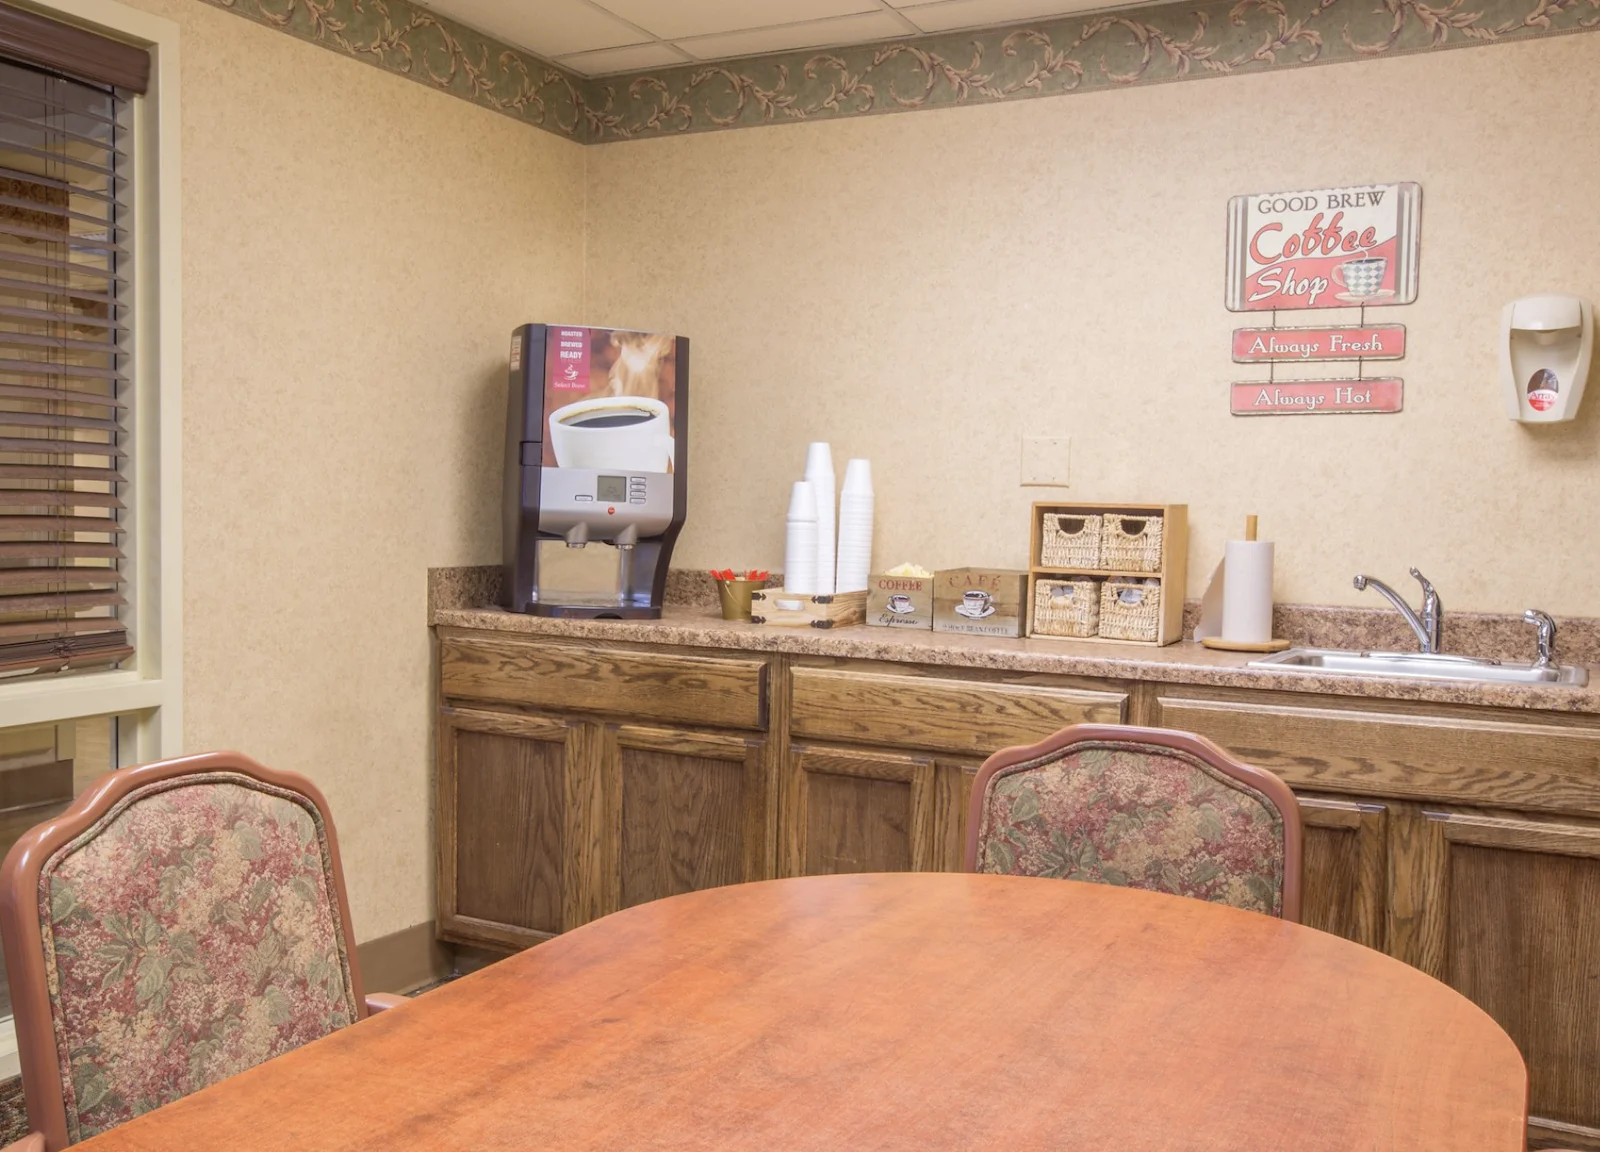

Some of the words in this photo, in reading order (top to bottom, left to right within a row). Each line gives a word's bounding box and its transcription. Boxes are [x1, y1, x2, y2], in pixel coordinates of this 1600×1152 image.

[1258, 197, 1318, 214] GOOD
[1327, 191, 1385, 209] BREW
[1249, 211, 1377, 265] Coffee
[1247, 267, 1329, 305] Shop
[560, 350, 583, 359] READY
[1248, 337, 1320, 358] Always
[1329, 334, 1382, 352] Fresh
[1254, 389, 1325, 410] Always
[1334, 387, 1371, 404] Hot
[878, 579, 923, 591] COFFEE
